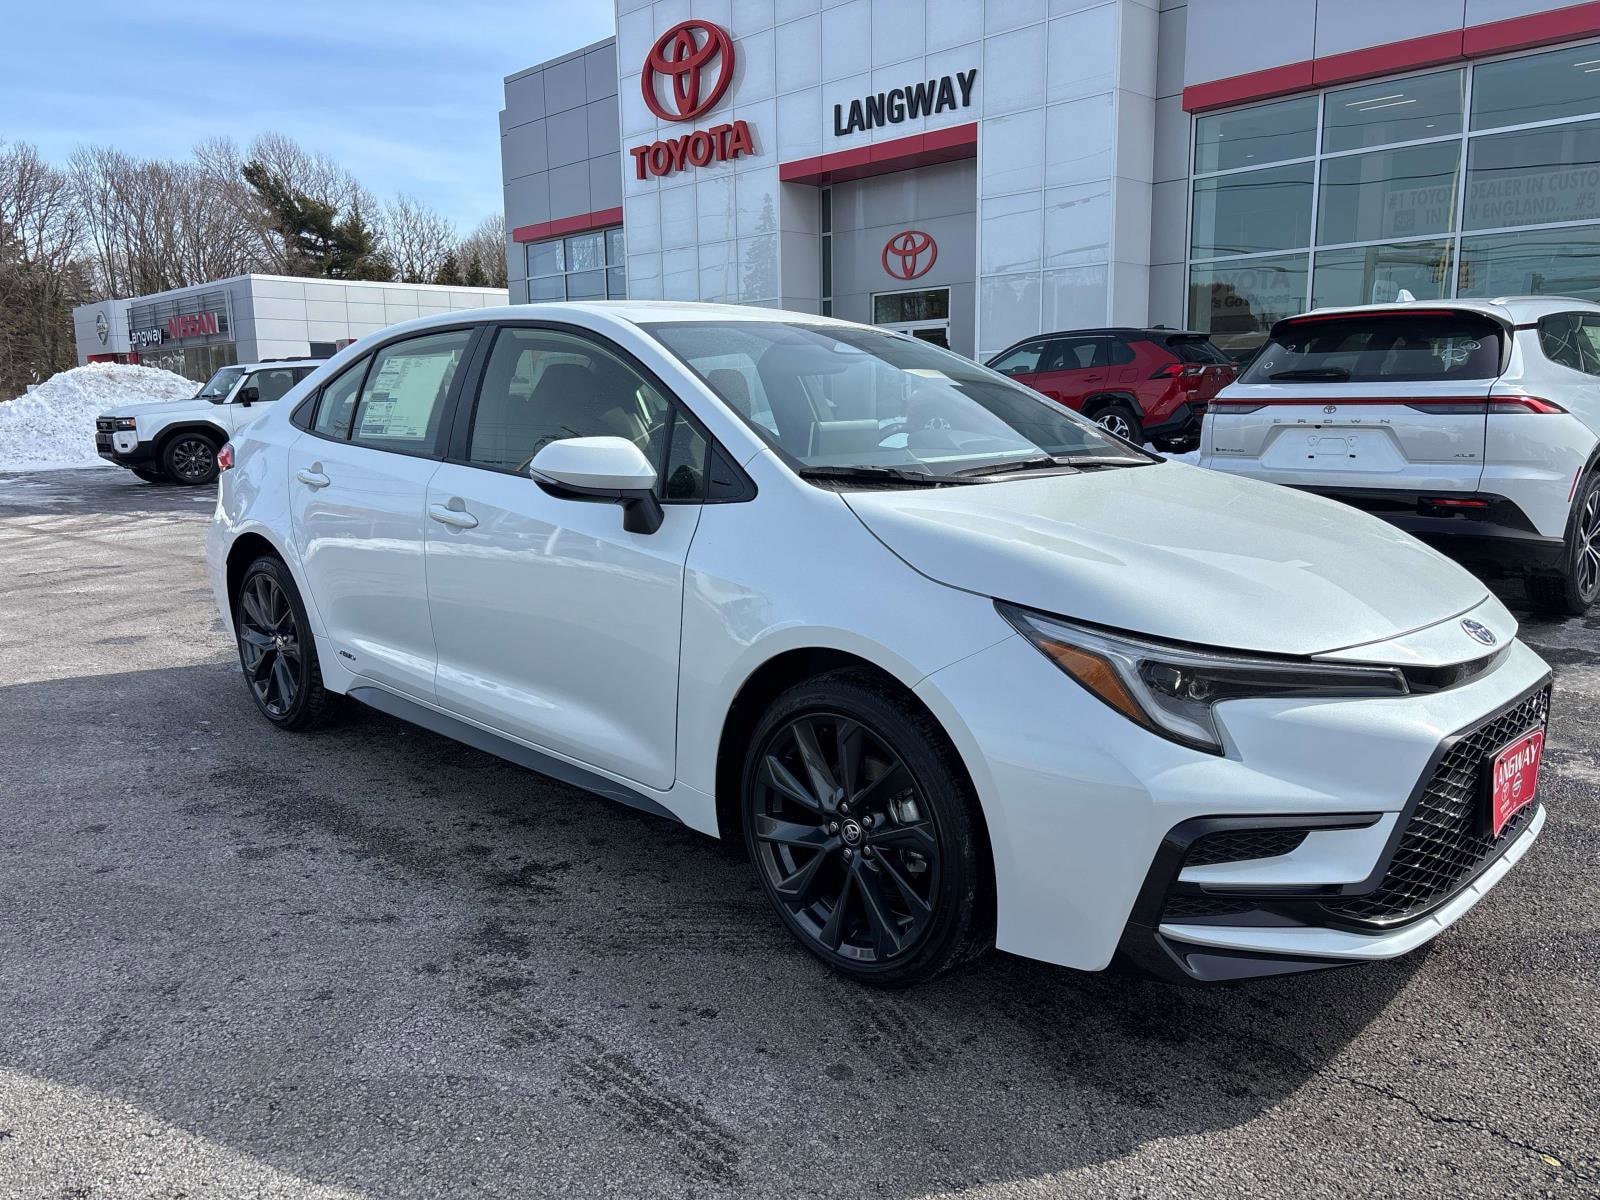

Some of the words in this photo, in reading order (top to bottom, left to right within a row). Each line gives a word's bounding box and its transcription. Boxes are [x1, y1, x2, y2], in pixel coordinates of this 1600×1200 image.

[834, 69, 977, 136] LANGWAY
[630, 120, 754, 180] TOYOTA
[1471, 179, 1522, 200] DEALER
[1525, 176, 1544, 193] IN
[1225, 295, 1243, 308] Go
[129, 328, 162, 346] Langway
[168, 311, 219, 339] NISSAN
[1494, 743, 1539, 794] LANGWAY
